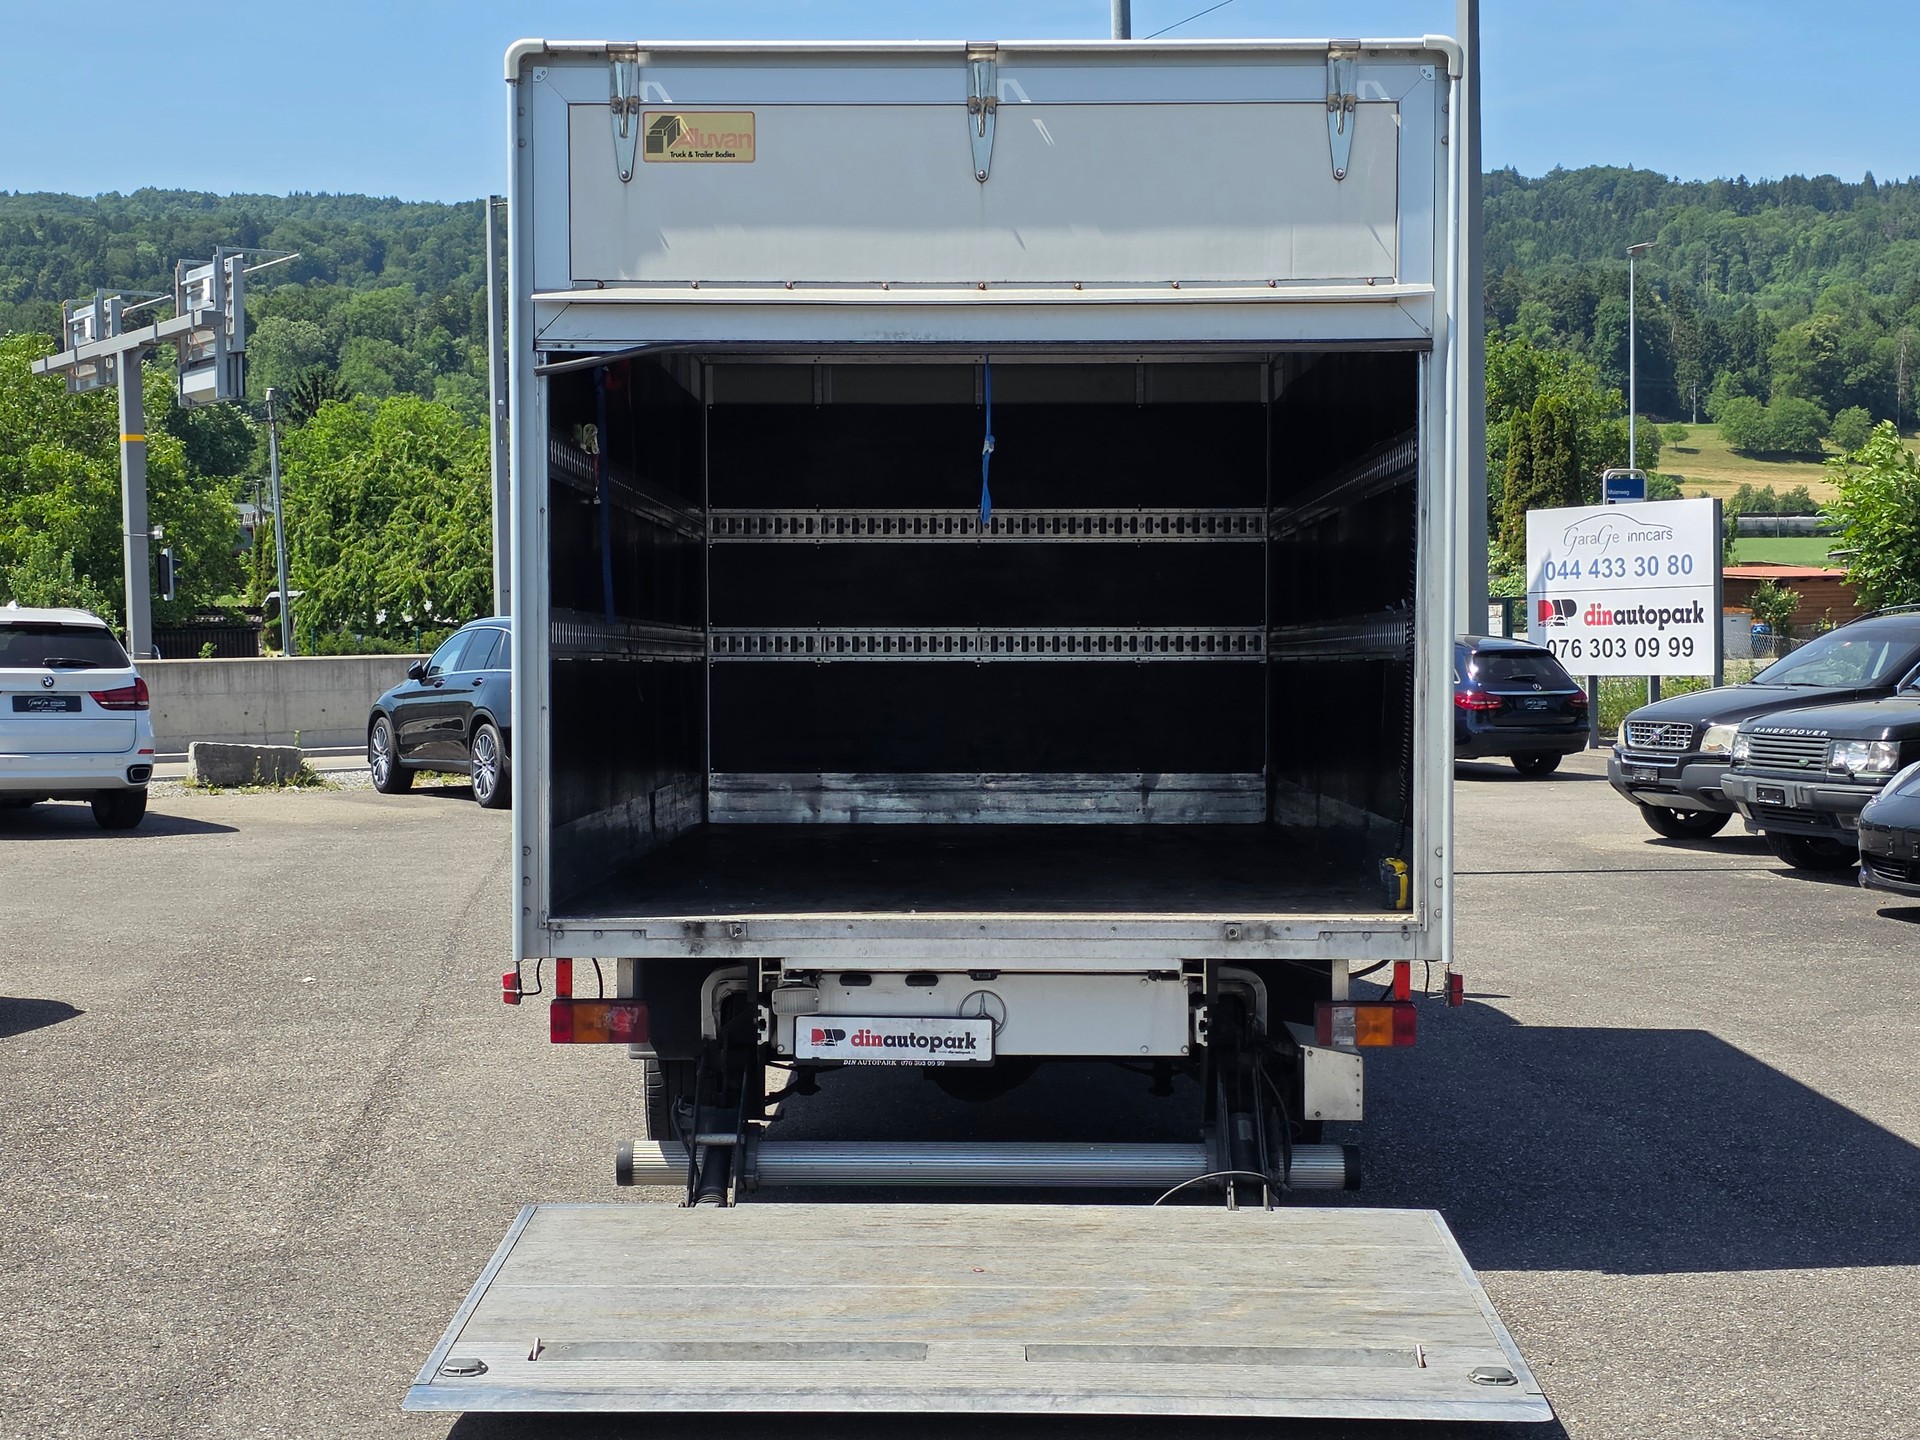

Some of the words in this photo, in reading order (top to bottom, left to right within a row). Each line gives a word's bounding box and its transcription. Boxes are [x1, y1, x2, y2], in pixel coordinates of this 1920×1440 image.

[671, 127, 753, 149] Aluvan
[694, 150, 714, 158] Trailer
[715, 150, 736, 158] Bodies
[1627, 529, 1673, 543] inncars
[1544, 559, 1581, 581] 044
[1588, 557, 1626, 579] 433
[1634, 555, 1659, 578] 30
[1667, 553, 1693, 576] 80
[1583, 600, 1704, 631] dinautopark
[1546, 639, 1582, 659] 076
[1589, 638, 1627, 658] 303
[1634, 637, 1660, 658] 09
[1668, 637, 1694, 657] 99
[1790, 728, 1828, 736] ROVER
[851, 1029, 977, 1053] dinautopark
